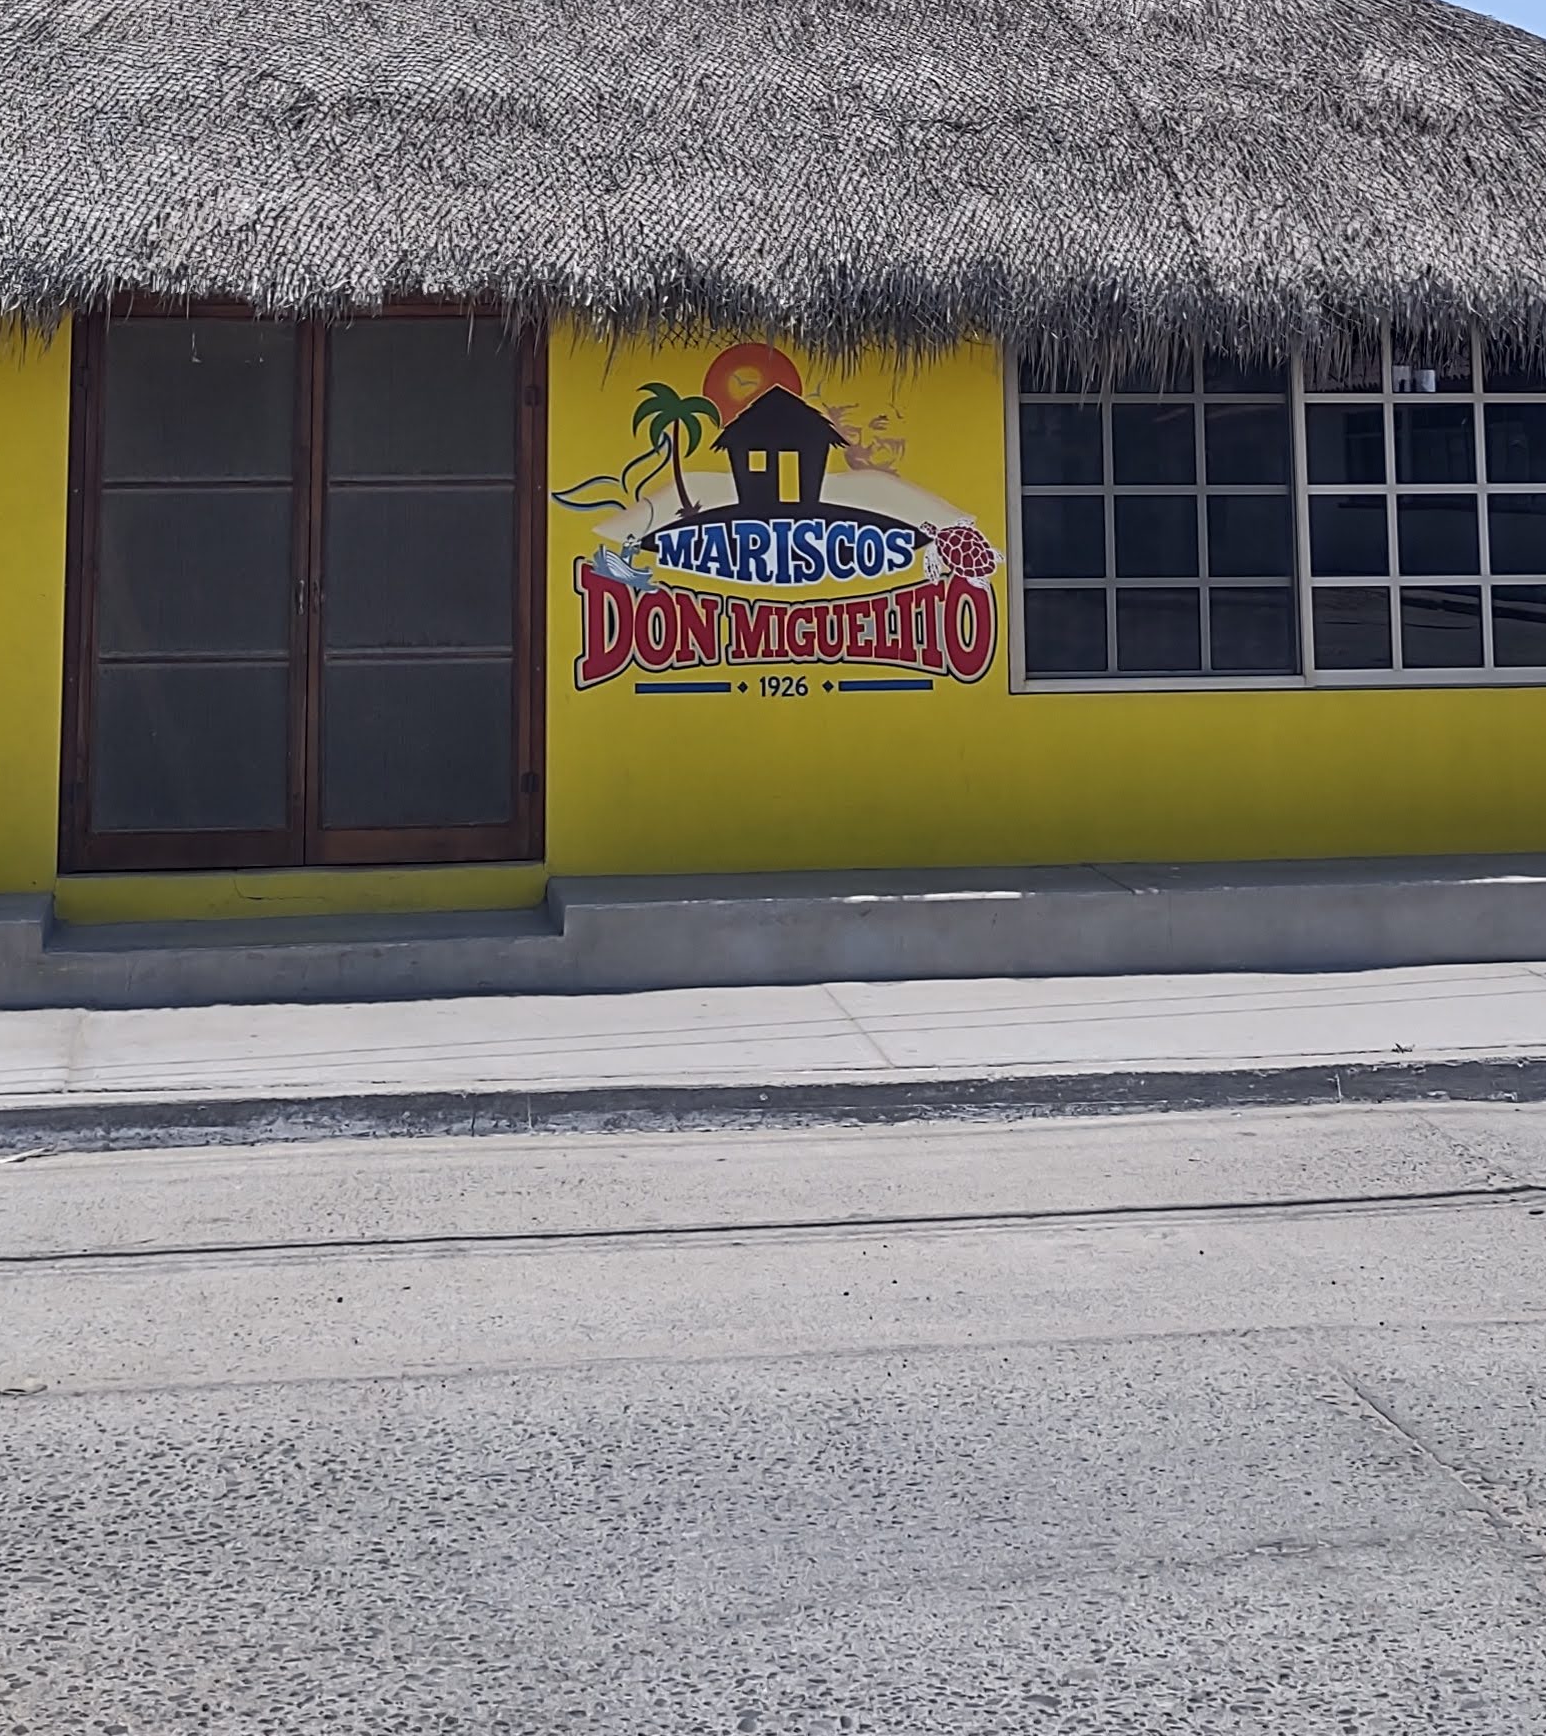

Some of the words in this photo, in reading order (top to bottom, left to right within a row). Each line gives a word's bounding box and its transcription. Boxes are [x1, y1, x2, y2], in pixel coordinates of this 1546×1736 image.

[655, 519, 916, 587] MARISCOS
[577, 560, 721, 684] DON
[729, 573, 994, 678] MIGUELITO
[759, 676, 810, 698] 1926
